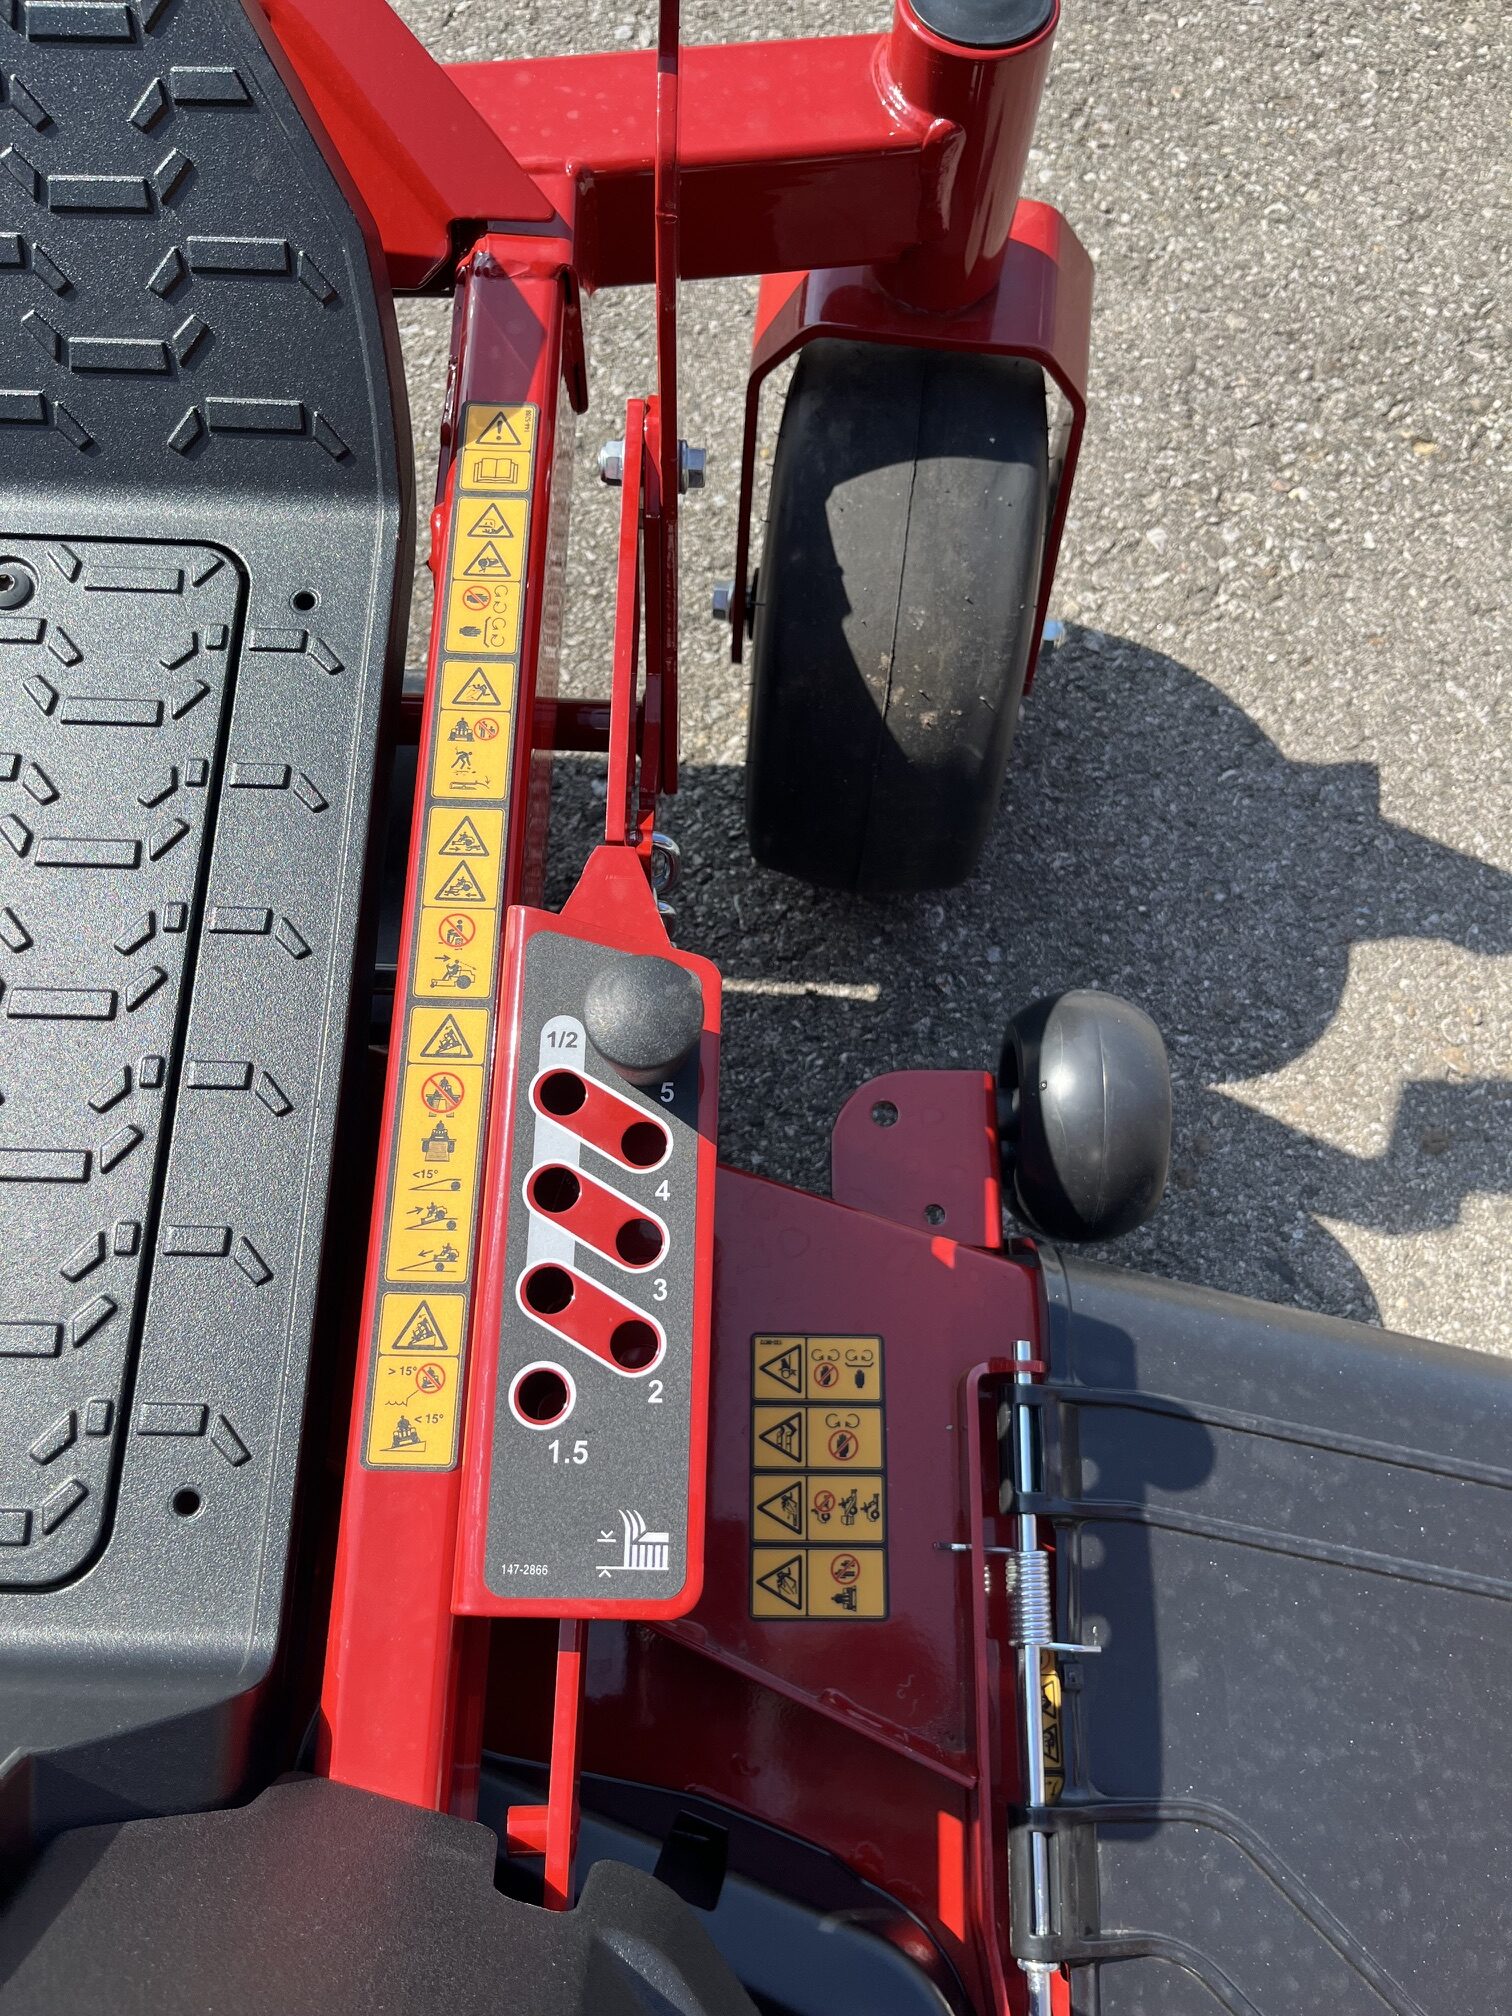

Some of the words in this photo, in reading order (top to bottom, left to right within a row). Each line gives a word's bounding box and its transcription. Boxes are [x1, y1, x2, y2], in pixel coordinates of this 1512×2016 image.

[546, 1031, 578, 1049] 1/2
[660, 1081, 675, 1102] 5
[655, 1179, 671, 1199] 4
[653, 1278, 668, 1301] 3
[648, 1380, 664, 1403] 2
[548, 1439, 589, 1464] 1.5
[500, 1563, 549, 1576] 147-2866
